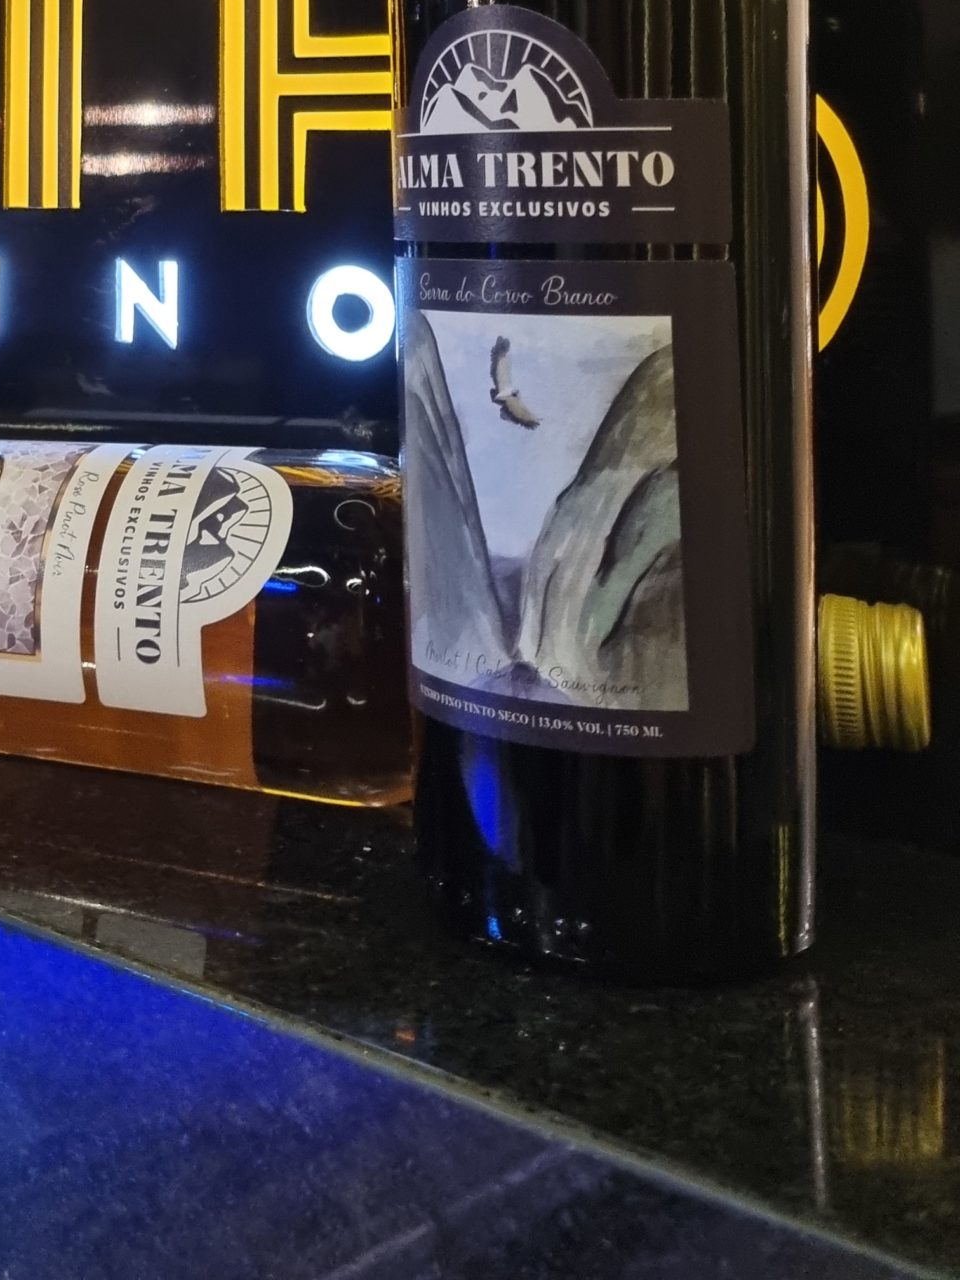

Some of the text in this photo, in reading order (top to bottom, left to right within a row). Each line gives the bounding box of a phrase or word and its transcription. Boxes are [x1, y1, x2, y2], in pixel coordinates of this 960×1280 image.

[477, 151, 675, 189] TRENTO
[419, 201, 611, 217] VINHOS EXCLUSIVOS
[419, 272, 451, 302] Serra
[456, 277, 474, 302] do
[541, 276, 619, 305] Branco
[114, 461, 163, 610] VINHOS EXCLUSIVOS
[135, 509, 178, 664] TRENTO
[461, 699, 496, 719] TINTO
[498, 709, 529, 725] SECO
[577, 721, 604, 735] VOL
[614, 723, 639, 737] 750
[642, 725, 663, 738] ML
